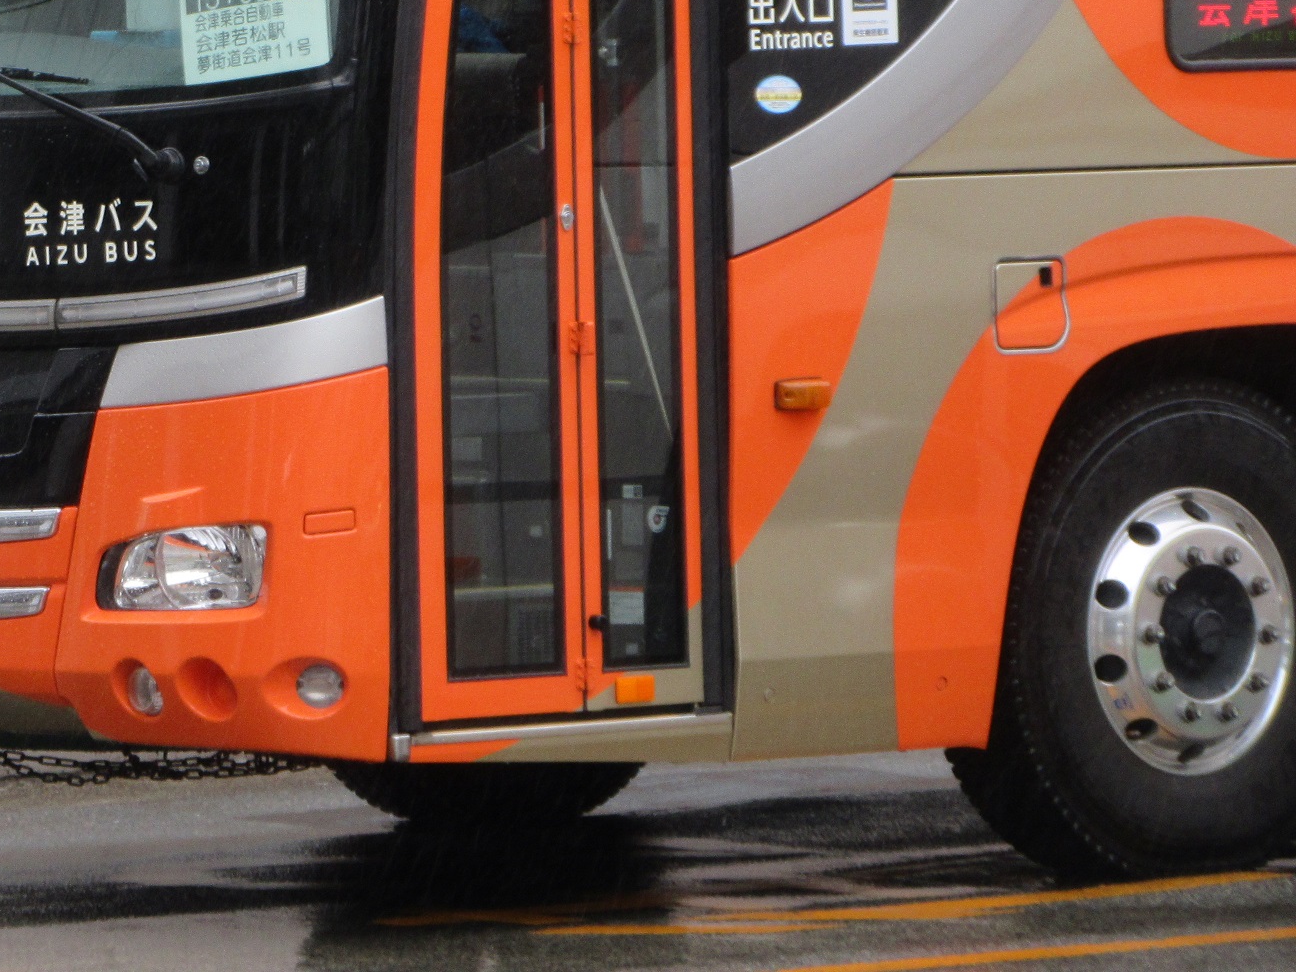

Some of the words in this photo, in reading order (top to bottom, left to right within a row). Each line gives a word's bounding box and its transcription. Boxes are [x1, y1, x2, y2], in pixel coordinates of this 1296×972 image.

[194, 1, 284, 33] 会津乗合自動車
[196, 21, 286, 54] 会津若松駅
[749, 28, 834, 51] Entrance
[197, 37, 312, 74] 夢街道会津11号
[23, 197, 158, 236] 会津バス
[26, 243, 88, 266] AIZU
[105, 239, 156, 263] BUS
